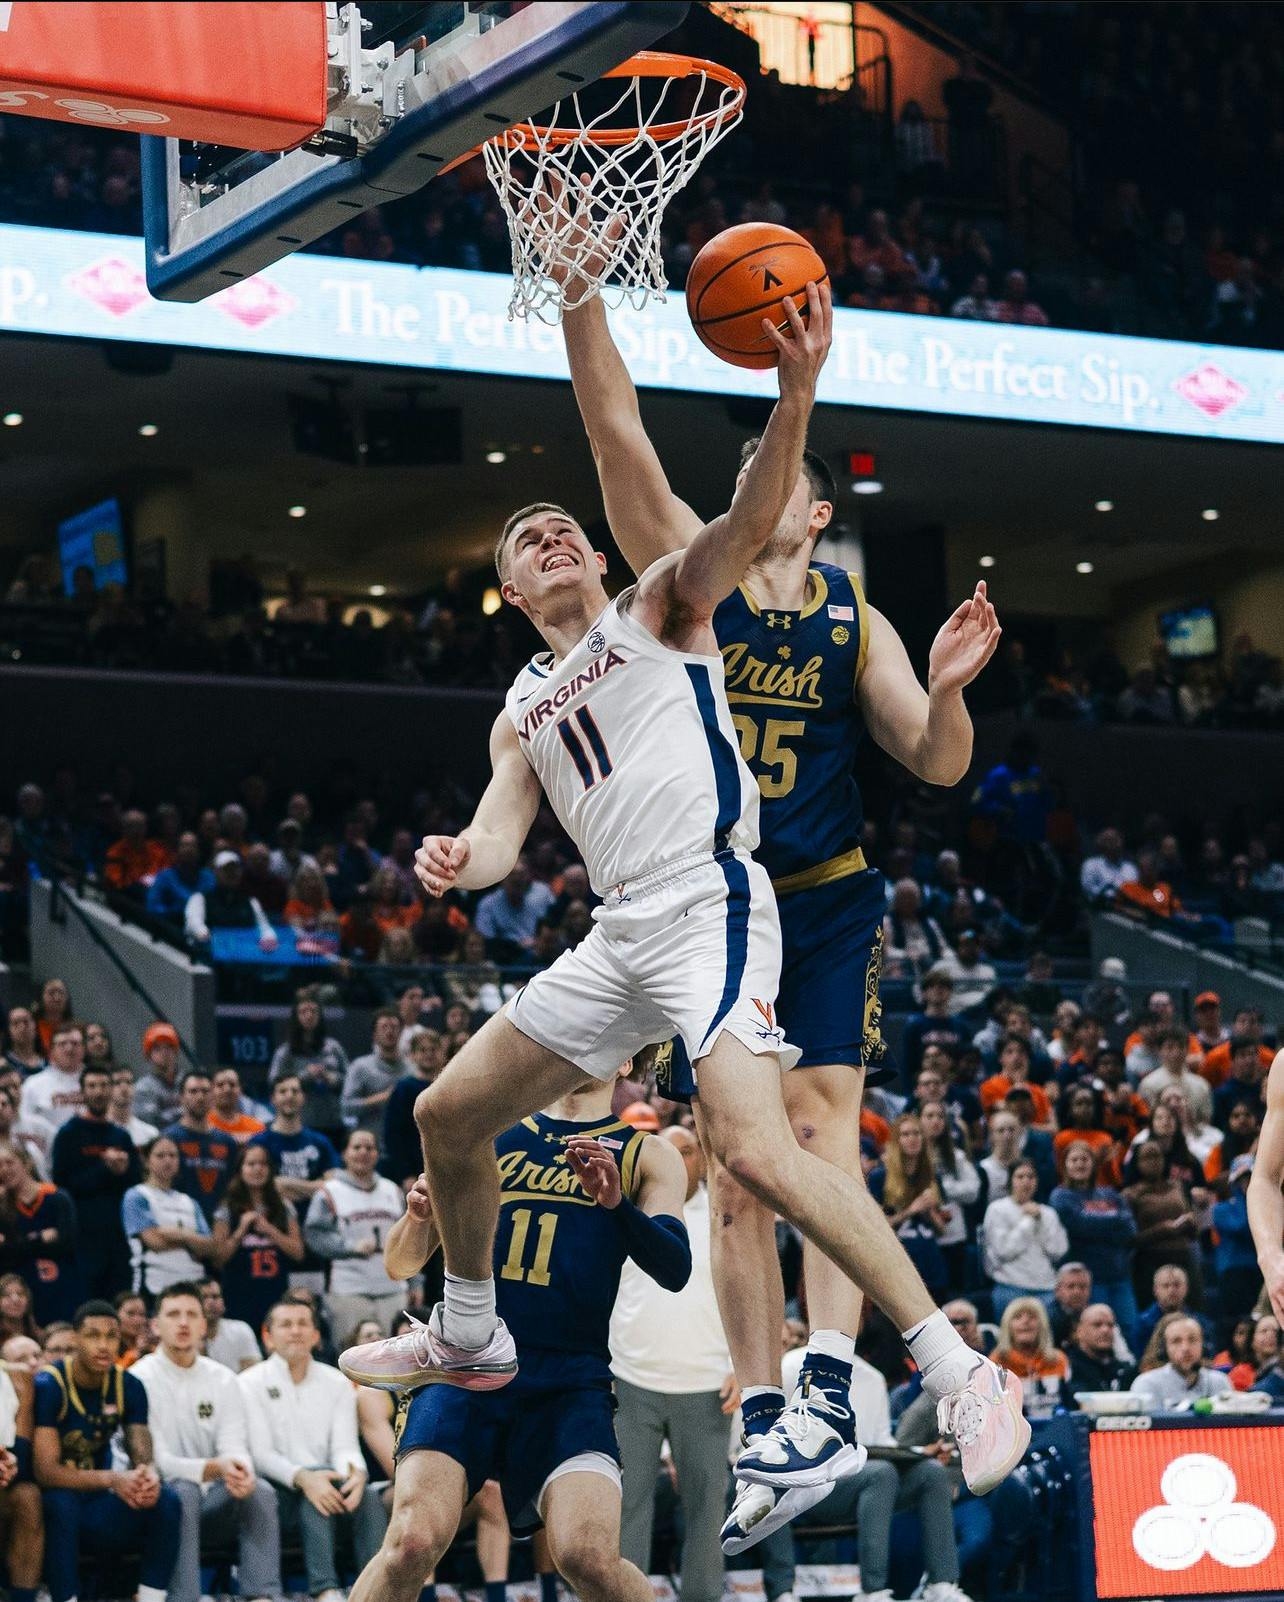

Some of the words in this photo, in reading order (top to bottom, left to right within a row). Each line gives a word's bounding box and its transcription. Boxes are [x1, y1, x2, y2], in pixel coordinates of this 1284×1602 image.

[320, 278, 421, 342] The
[434, 289, 562, 352] Perfe
[612, 309, 702, 380] Sip.
[833, 328, 911, 385] The
[922, 334, 1069, 400] Perfect
[1081, 352, 1160, 421] Sip.
[518, 649, 628, 742] VIRGINIA
[721, 642, 823, 709] Irish
[556, 703, 614, 792] 11
[231, 1036, 268, 1061] 103
[251, 1249, 278, 1278] 15
[501, 1208, 559, 1287] 11
